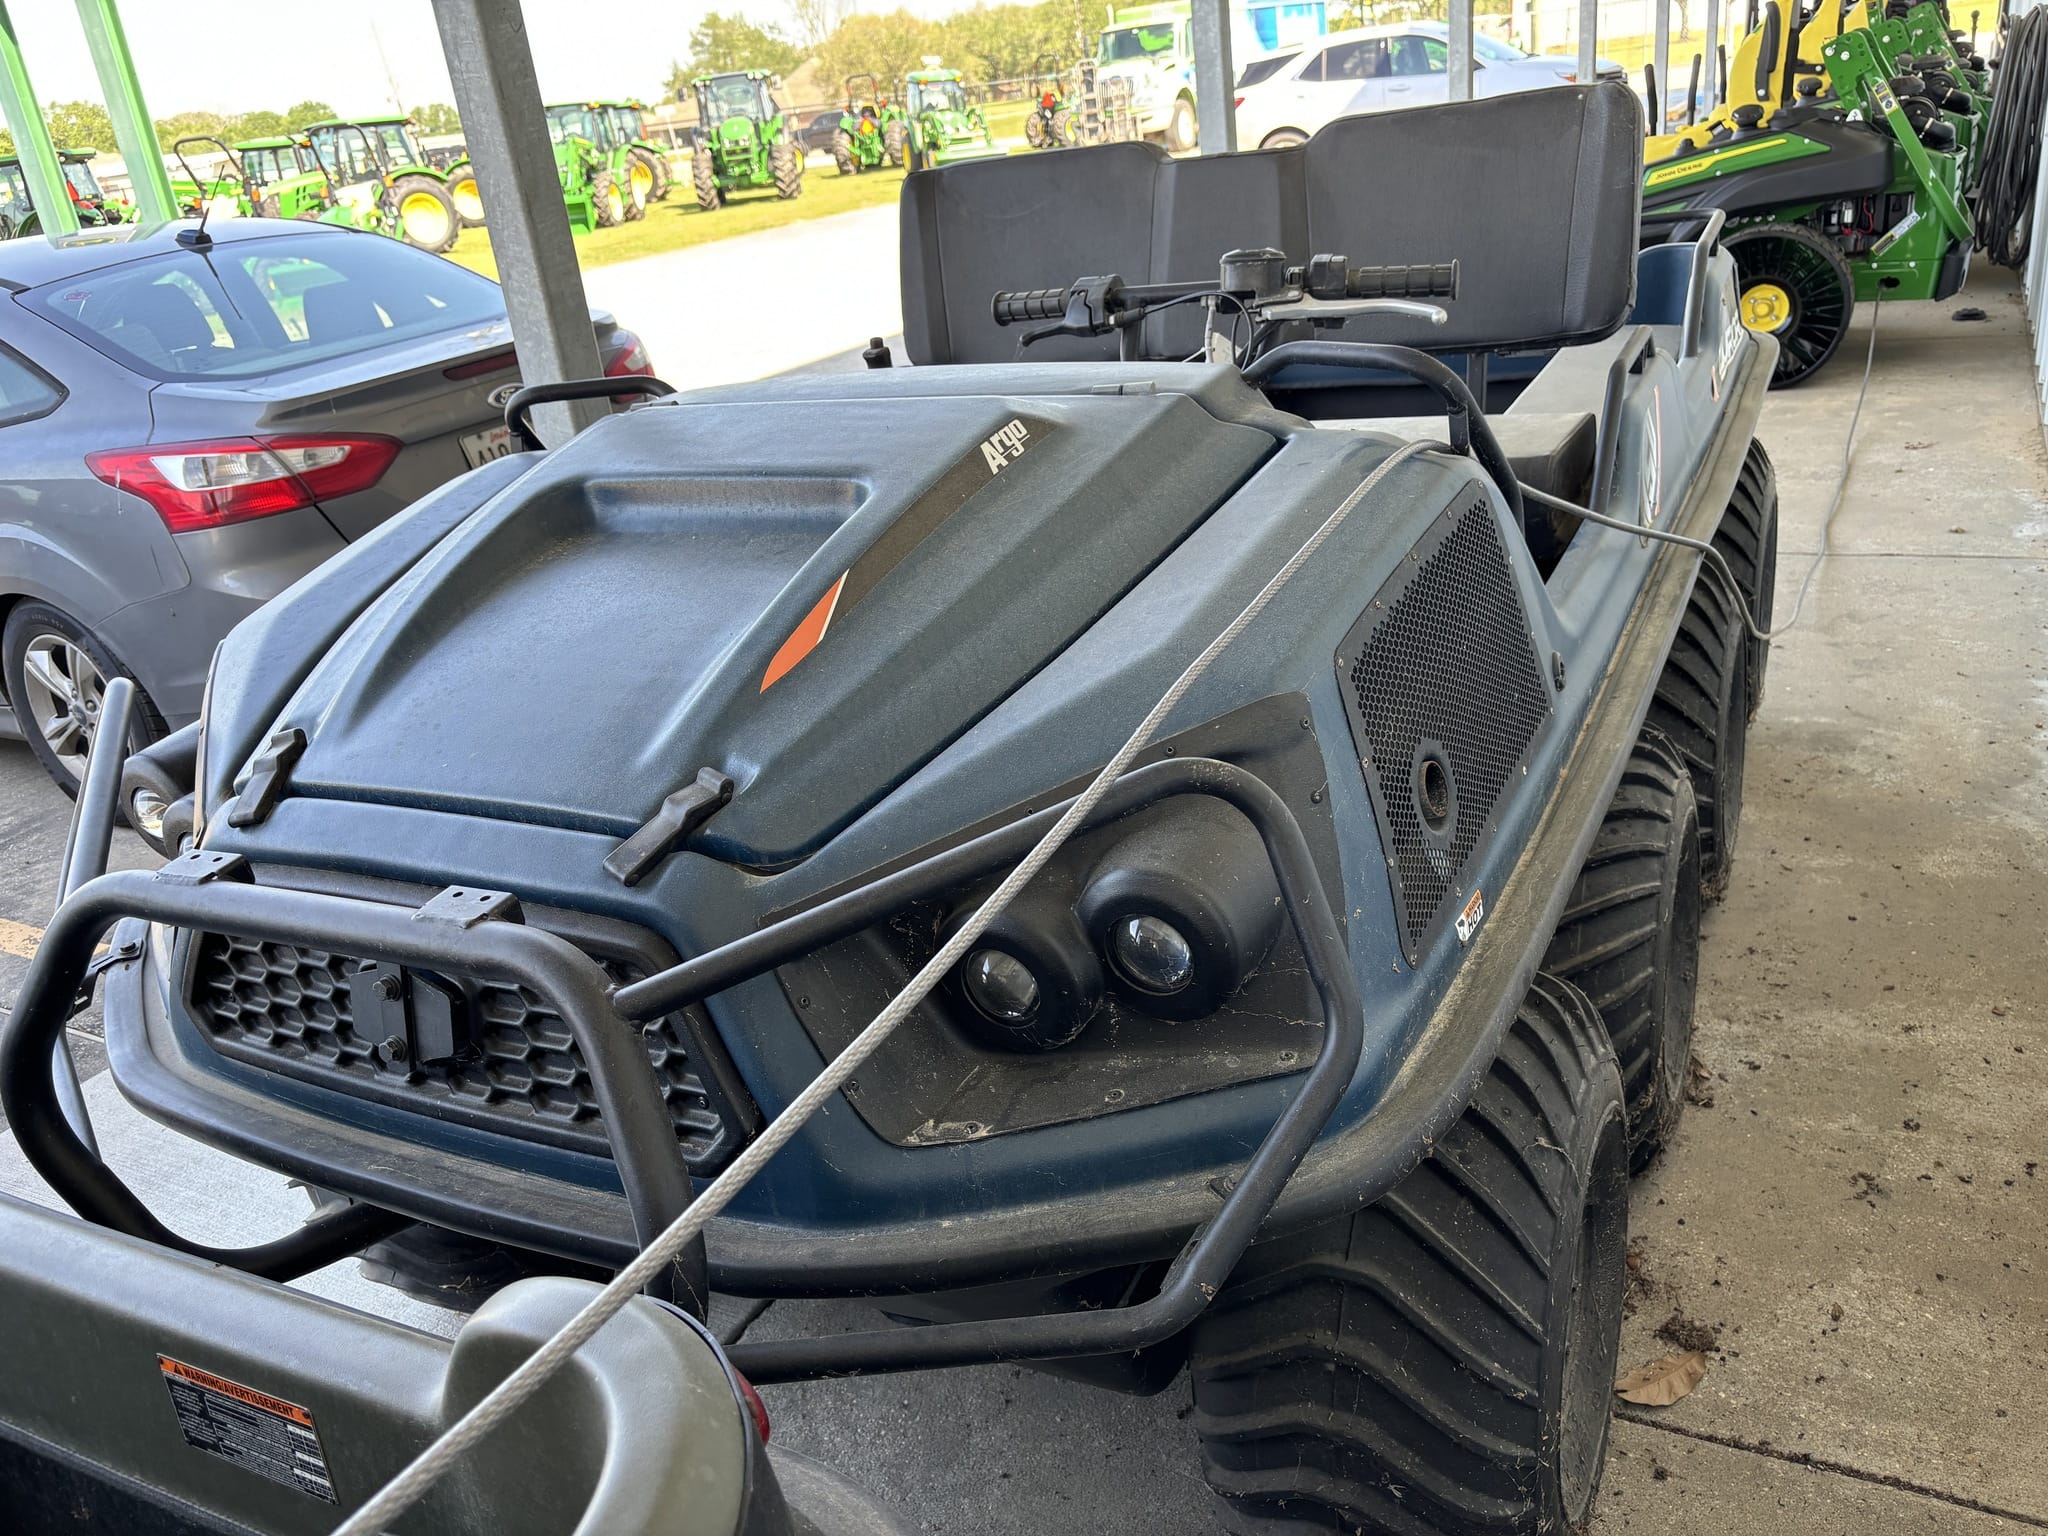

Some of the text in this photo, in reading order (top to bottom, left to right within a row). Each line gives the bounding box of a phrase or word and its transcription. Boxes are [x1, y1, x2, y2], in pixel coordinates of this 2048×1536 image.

[1656, 163, 1703, 180] JOHN DEERE
[980, 419, 1030, 475] Argo
[1467, 902, 1482, 934] HOT
[182, 1366, 295, 1418] WARNING/AVERTISSEMENT
